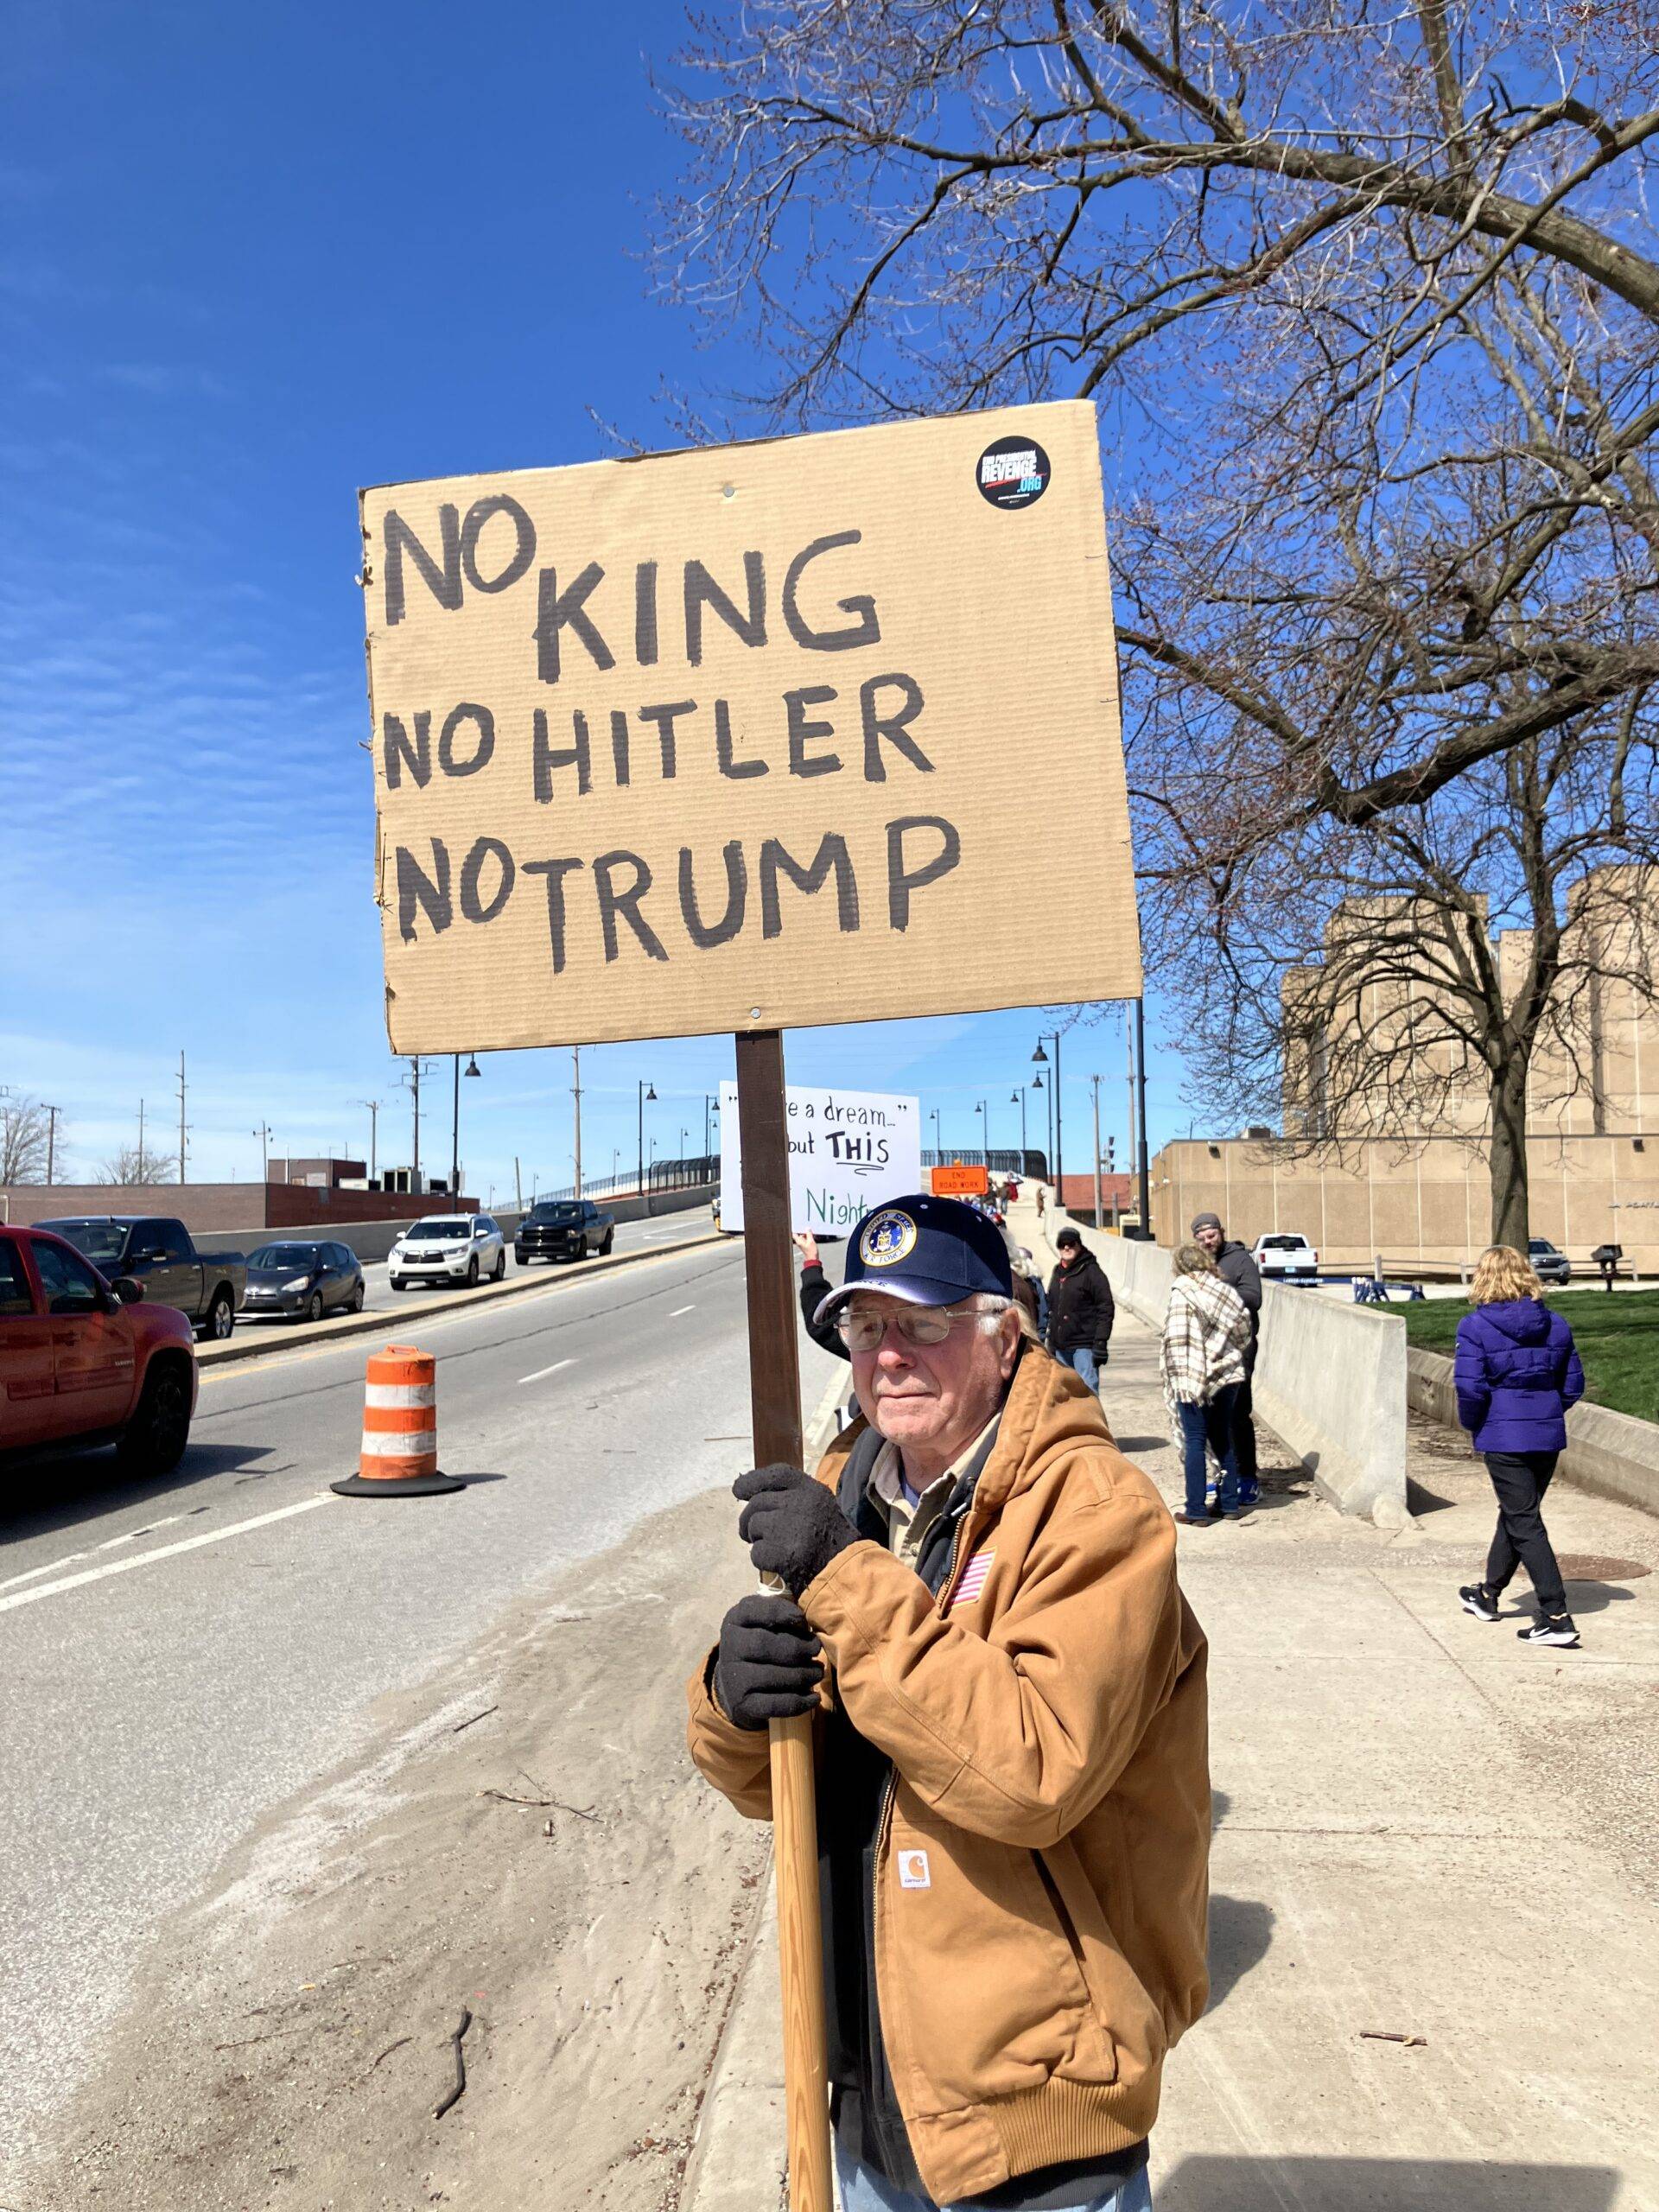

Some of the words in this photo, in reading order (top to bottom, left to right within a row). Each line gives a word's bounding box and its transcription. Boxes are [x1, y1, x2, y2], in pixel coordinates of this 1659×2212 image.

[982, 460, 1037, 484] REVENGE
[1017, 475, 1042, 493] .ORG
[385, 493, 537, 626] NO
[531, 529, 881, 684] KING
[383, 702, 495, 790] NO
[532, 672, 937, 804] HITLER
[395, 836, 516, 944] NO
[520, 816, 961, 975] TRUMP
[805, 1103, 815, 1118] a
[952, 1171, 966, 1179] END
